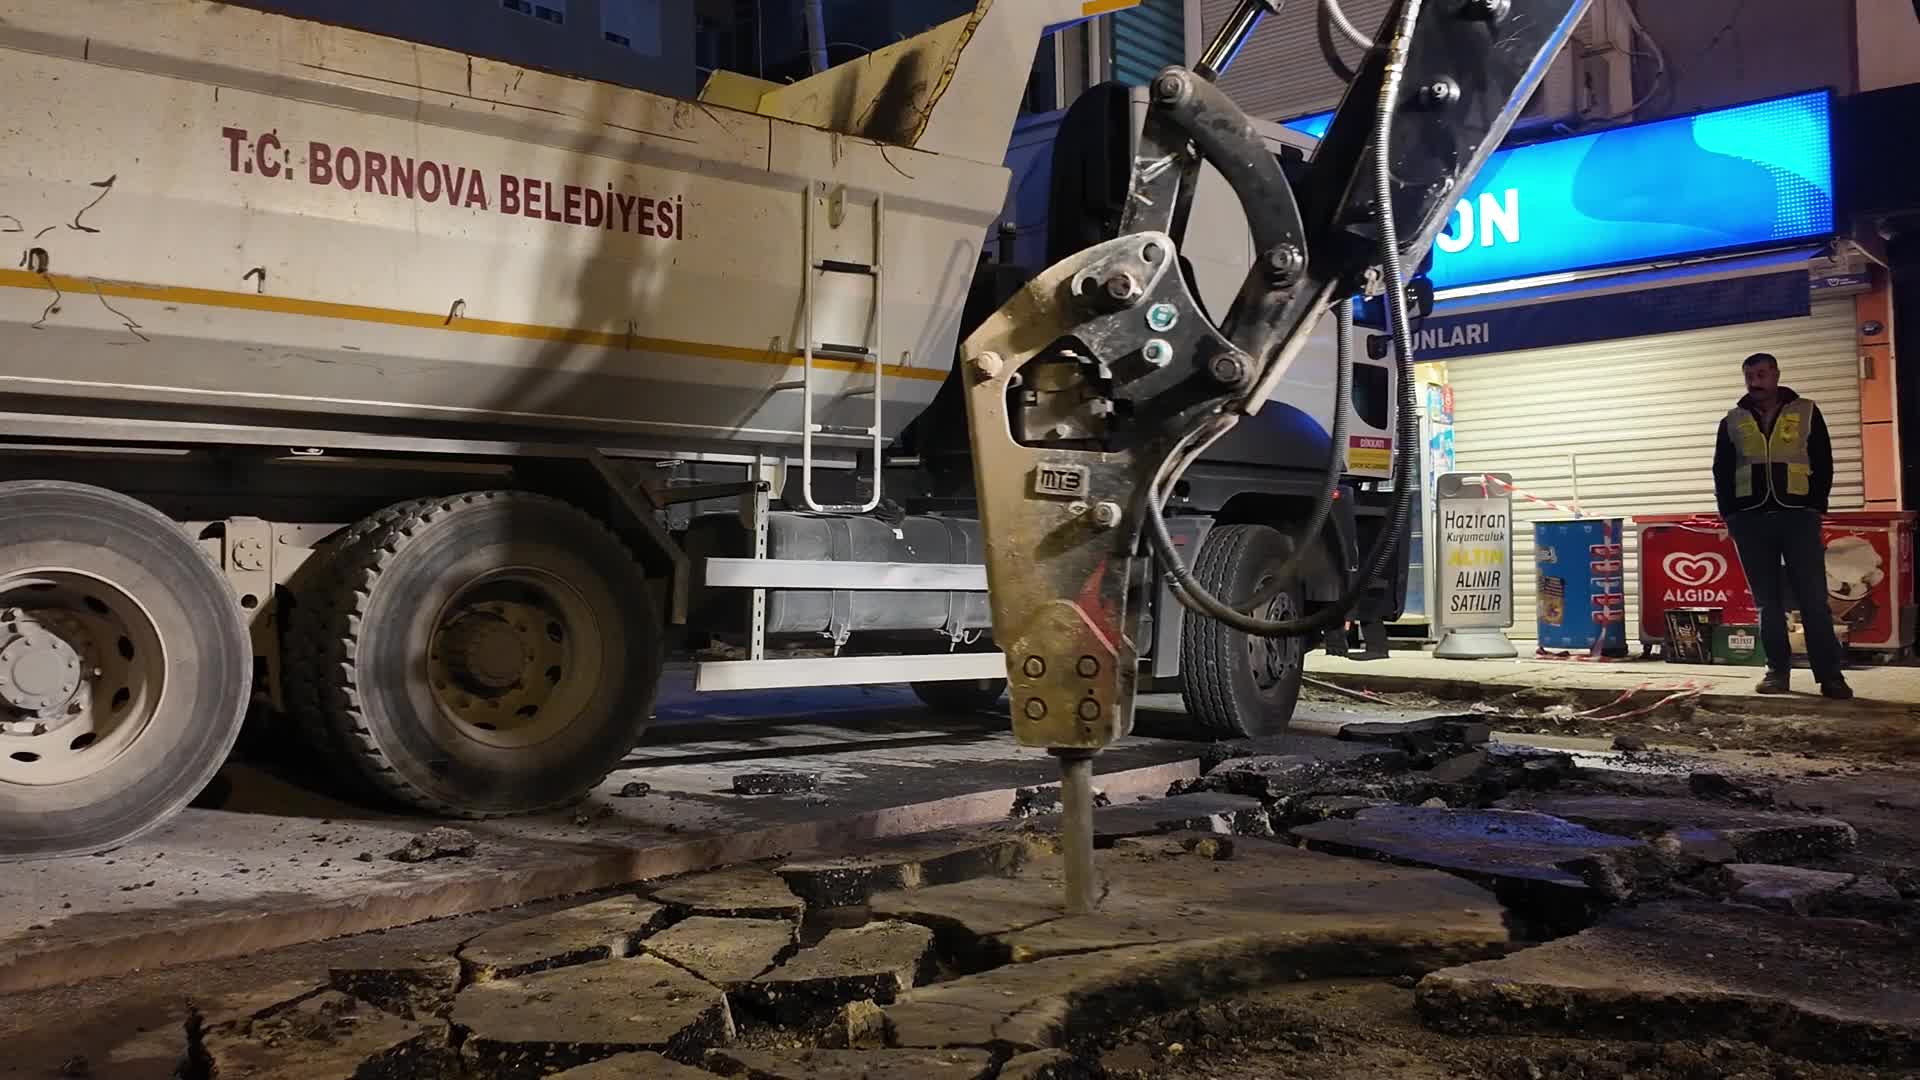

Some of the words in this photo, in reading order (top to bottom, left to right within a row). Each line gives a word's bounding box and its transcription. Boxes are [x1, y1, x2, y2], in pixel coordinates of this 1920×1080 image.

[309, 141, 487, 210] BORNOVA
[500, 174, 682, 240] BELEDİYESİ
[1446, 531, 1505, 544] Kuyumculuk
[1447, 549, 1505, 567] ALTIN
[1456, 570, 1501, 588] ALINIR
[1450, 594, 1502, 612] SATILIR
